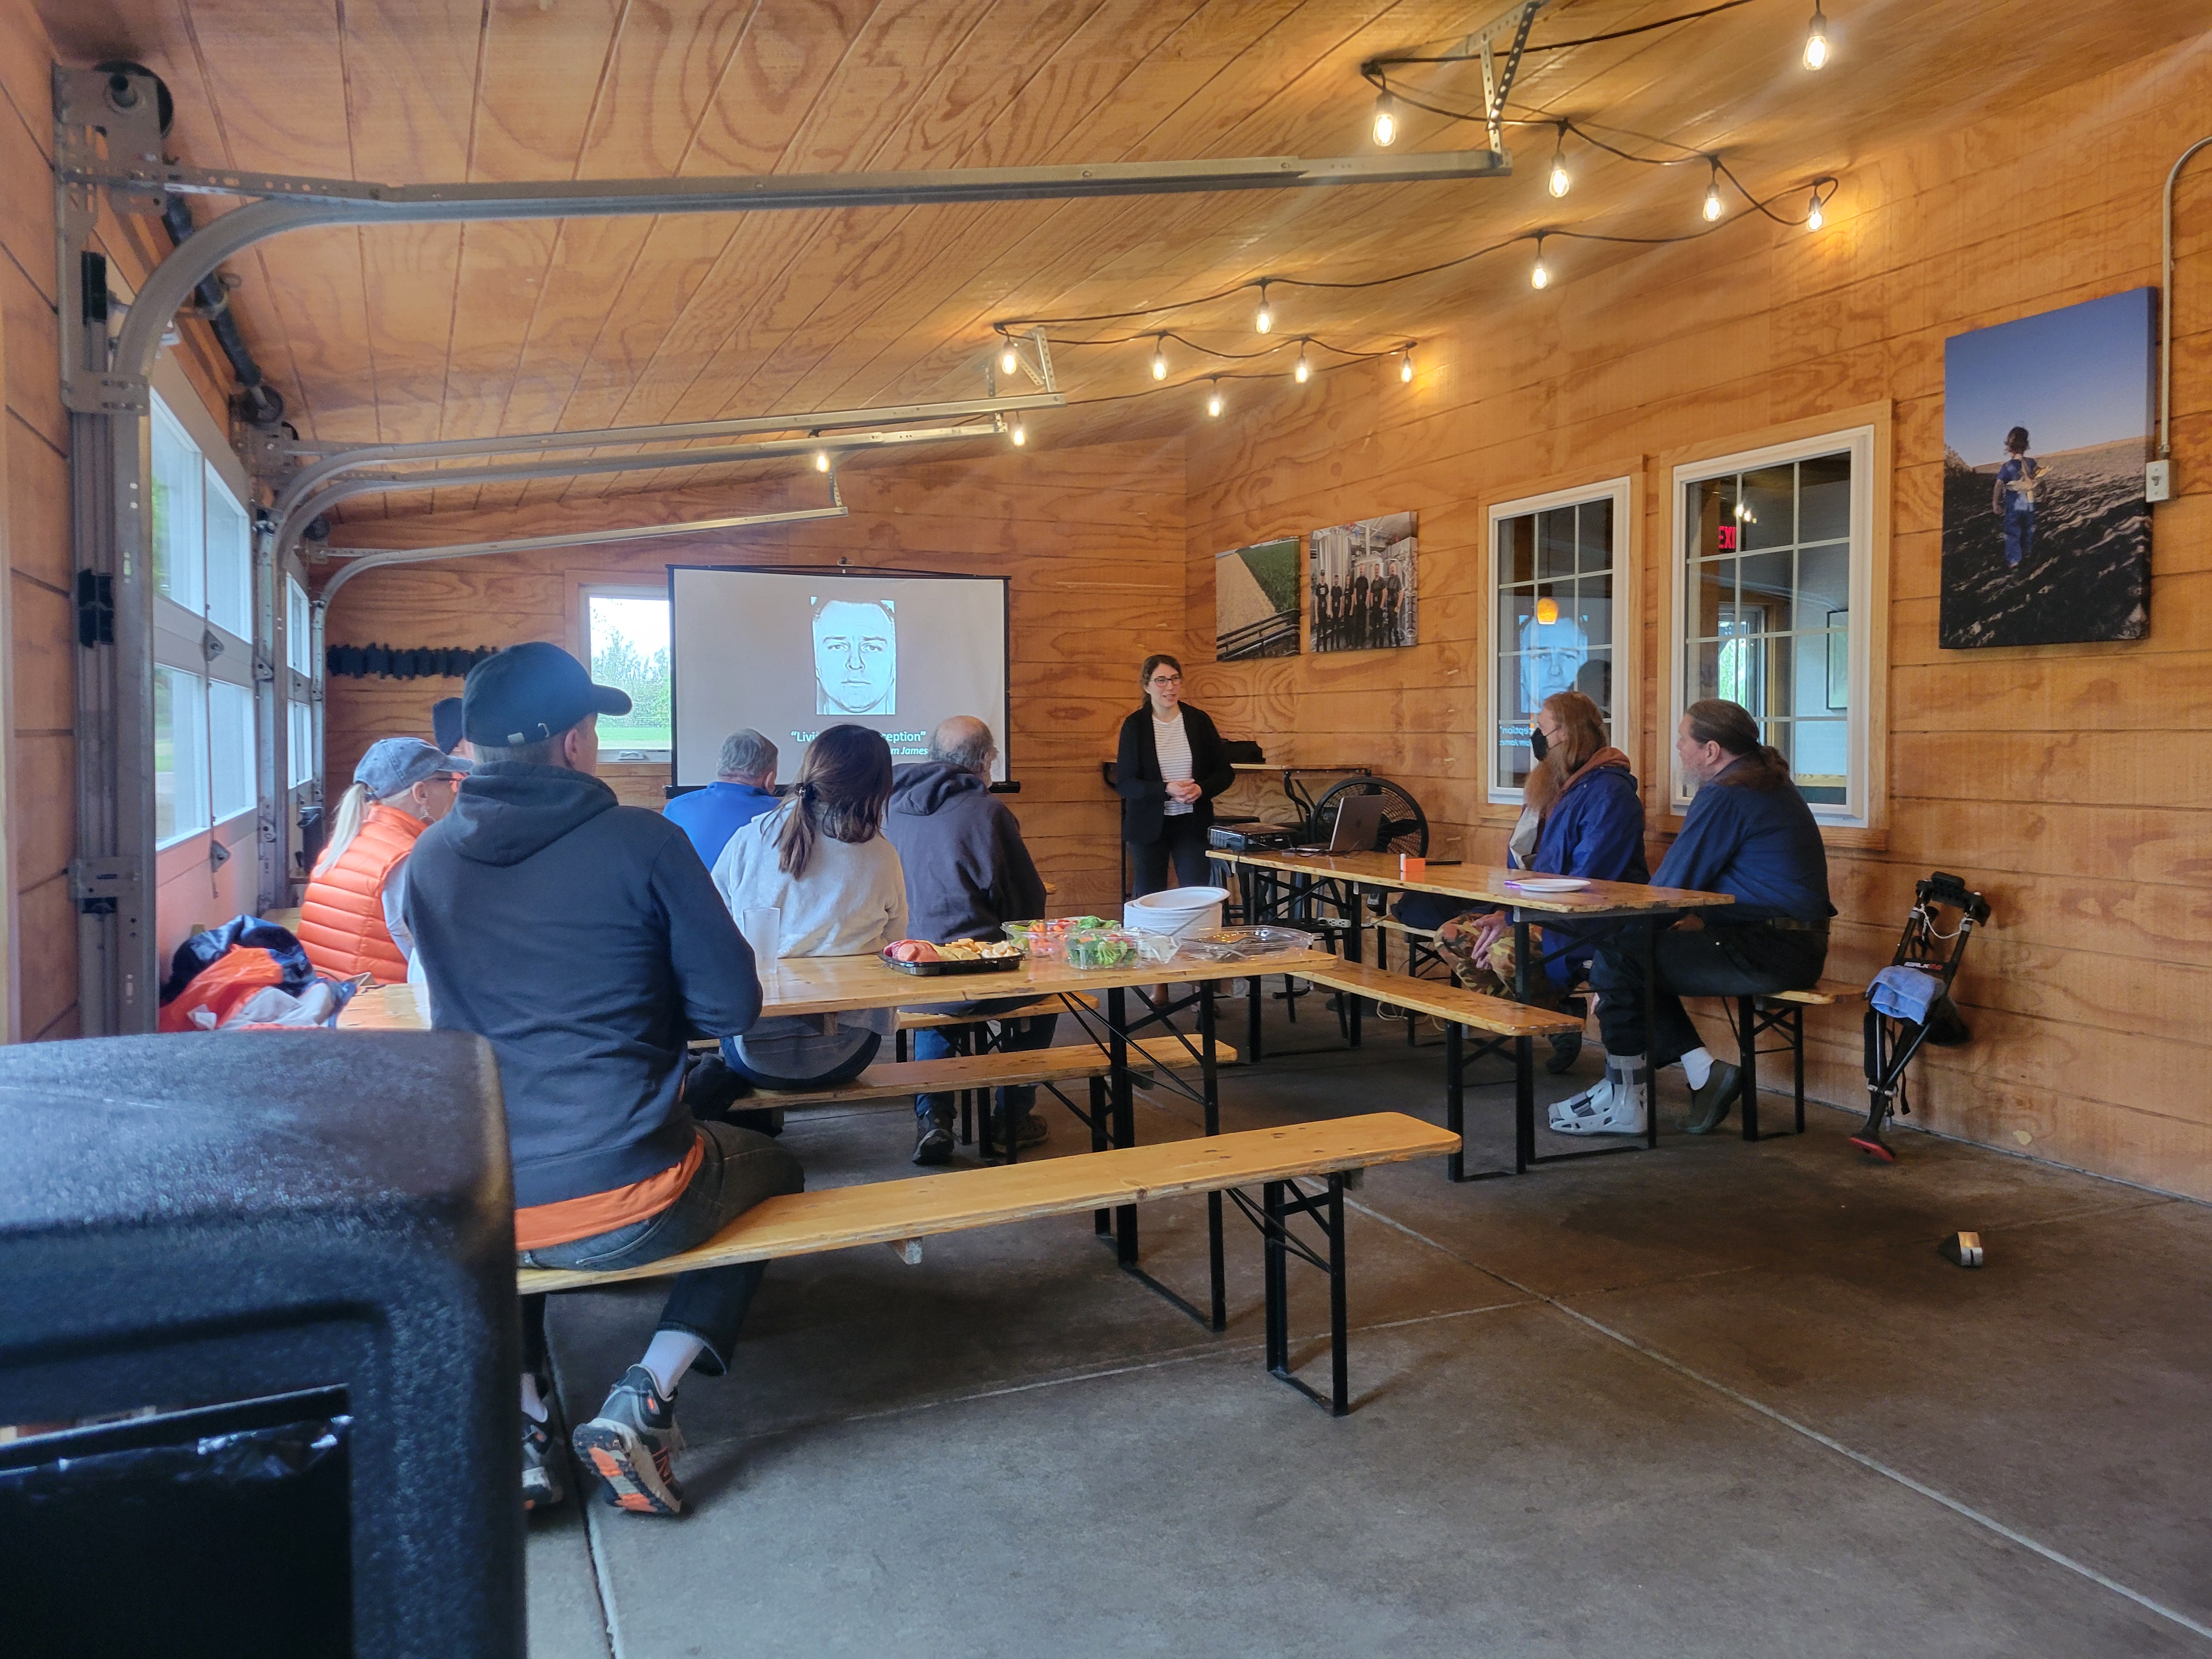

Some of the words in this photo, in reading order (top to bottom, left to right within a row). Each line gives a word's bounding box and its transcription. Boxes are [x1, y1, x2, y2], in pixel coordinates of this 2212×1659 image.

[1718, 526, 1736, 549] EXI
[791, 731, 819, 742] “Livi
[900, 746, 928, 755] James
